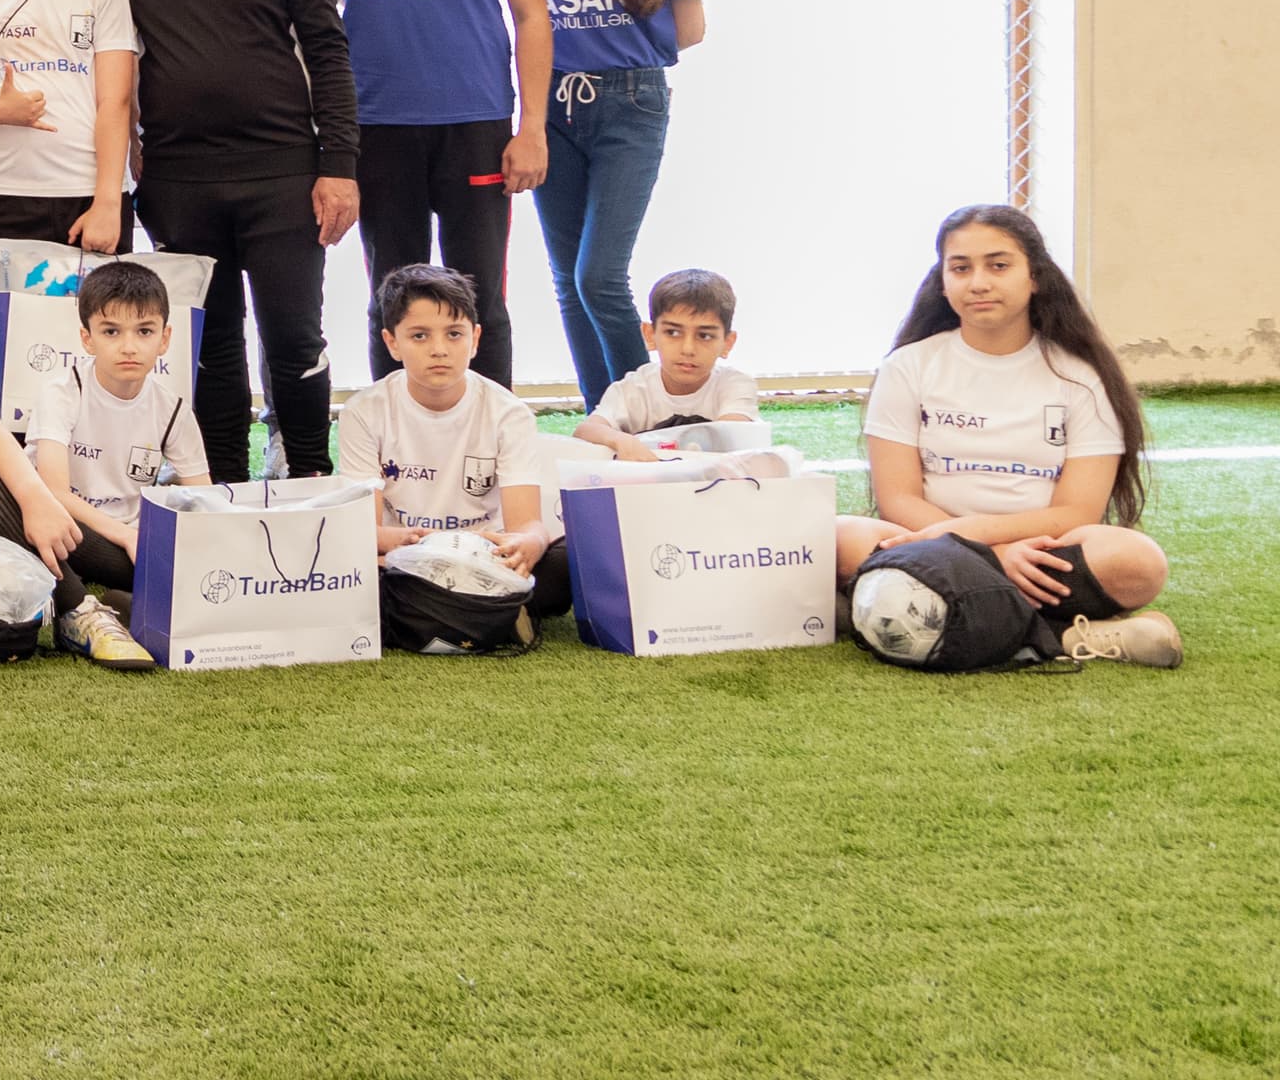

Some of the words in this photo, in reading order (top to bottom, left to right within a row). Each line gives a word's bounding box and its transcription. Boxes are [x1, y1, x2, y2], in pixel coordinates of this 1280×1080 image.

[549, 12, 635, 32] NÜLLÜLƏR
[0, 26, 38, 39] YAŞAT
[935, 411, 989, 429] YAŞAT
[72, 443, 103, 460] YAAT
[399, 465, 438, 481] YAŞAT
[685, 545, 814, 572] TuranBank
[238, 568, 363, 597] TuranBank
